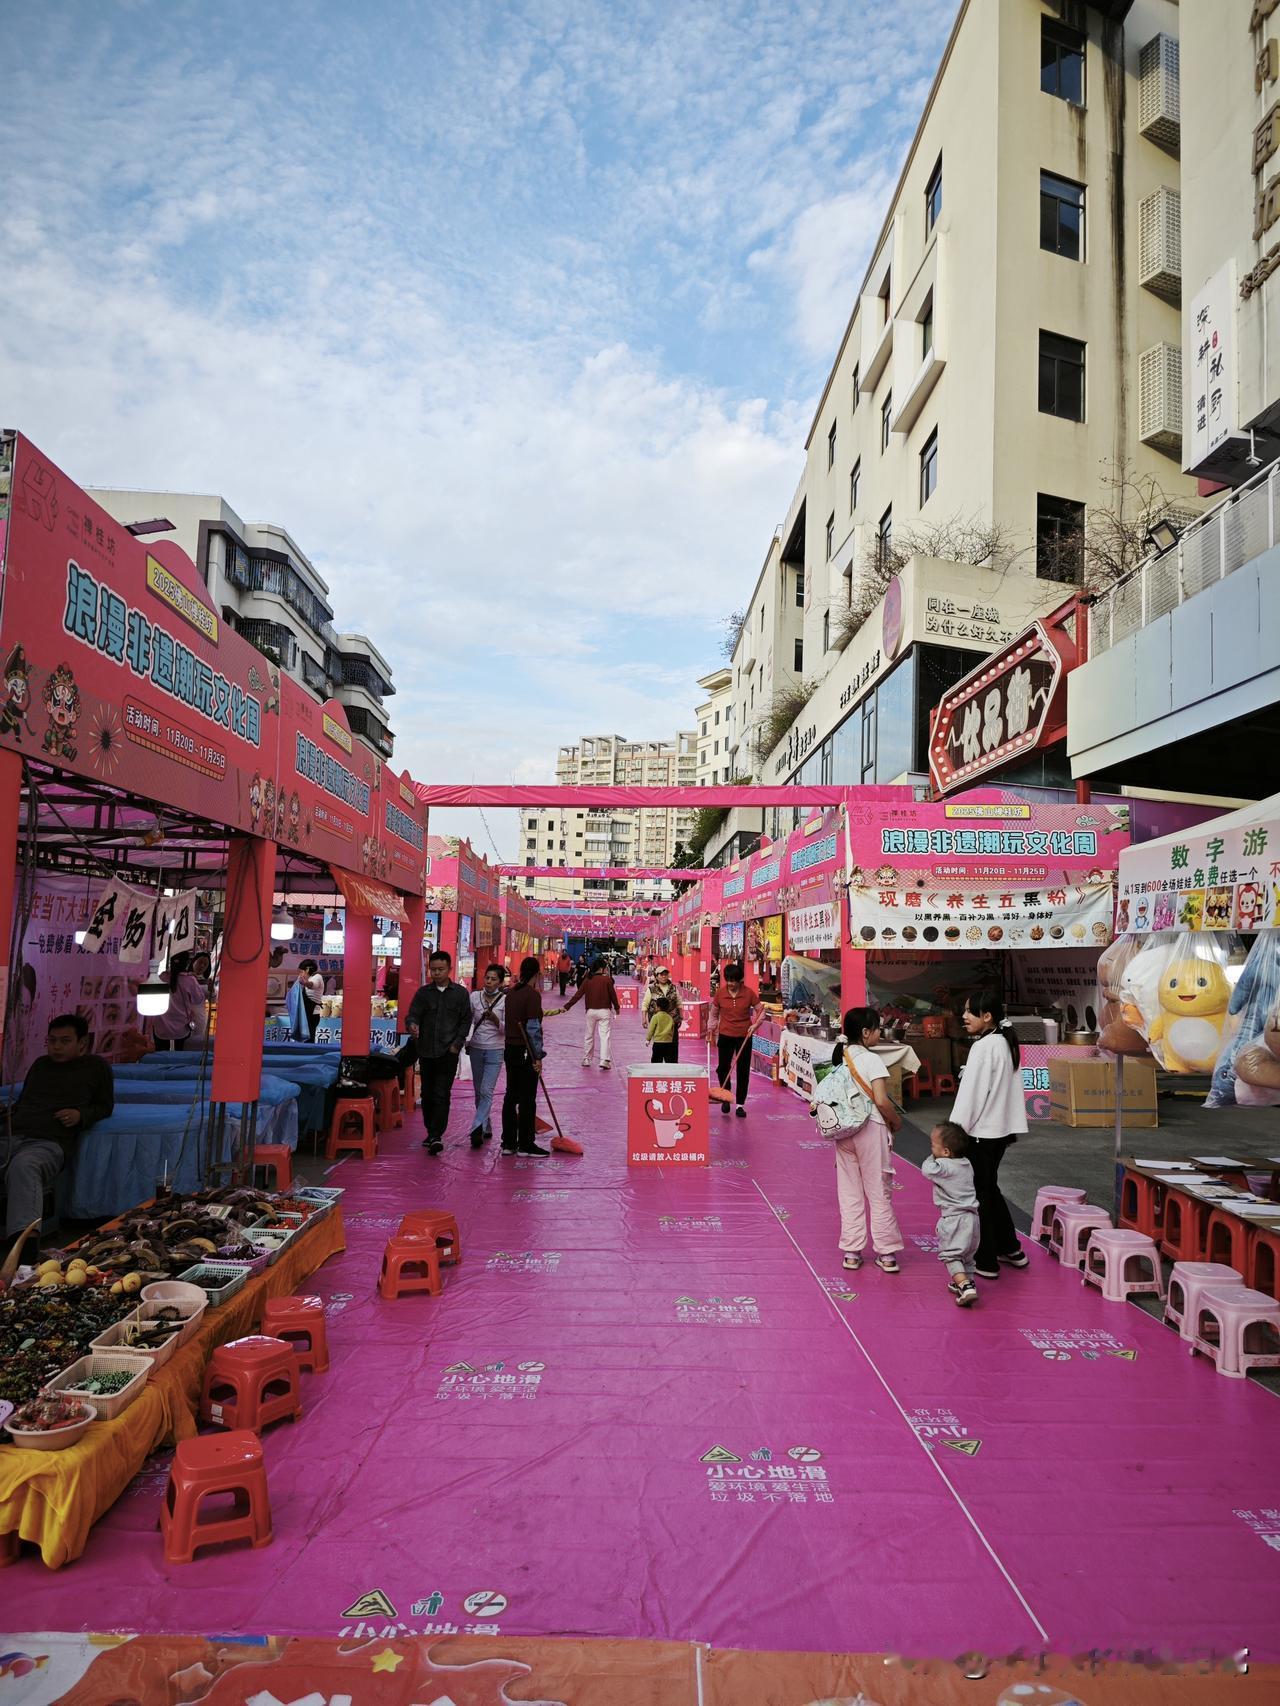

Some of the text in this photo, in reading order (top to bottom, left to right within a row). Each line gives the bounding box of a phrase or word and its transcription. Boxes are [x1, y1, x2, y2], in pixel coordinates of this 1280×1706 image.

[927, 598, 1000, 624] 同在一座城
[927, 616, 1017, 644] 为什么好久不
[63, 559, 260, 748] 浪漫非遗潮玩文化周
[882, 829, 1097, 855] 浪漫非遗潮玩文化周
[1171, 827, 1268, 870] 数字游
[878, 887, 1086, 910] 现磨《养生五黑粉》
[642, 1081, 697, 1094] 温馨提示
[632, 1152, 705, 1161] 垃圾请放入垃圾桶内
[675, 1304, 758, 1312] 小心地滑
[441, 1374, 542, 1384] 小心地滑
[706, 1464, 827, 1480] 小心地滑
[708, 1482, 831, 1492] 爱环境 爱生活
[710, 1492, 835, 1503] 垃圾不落地
